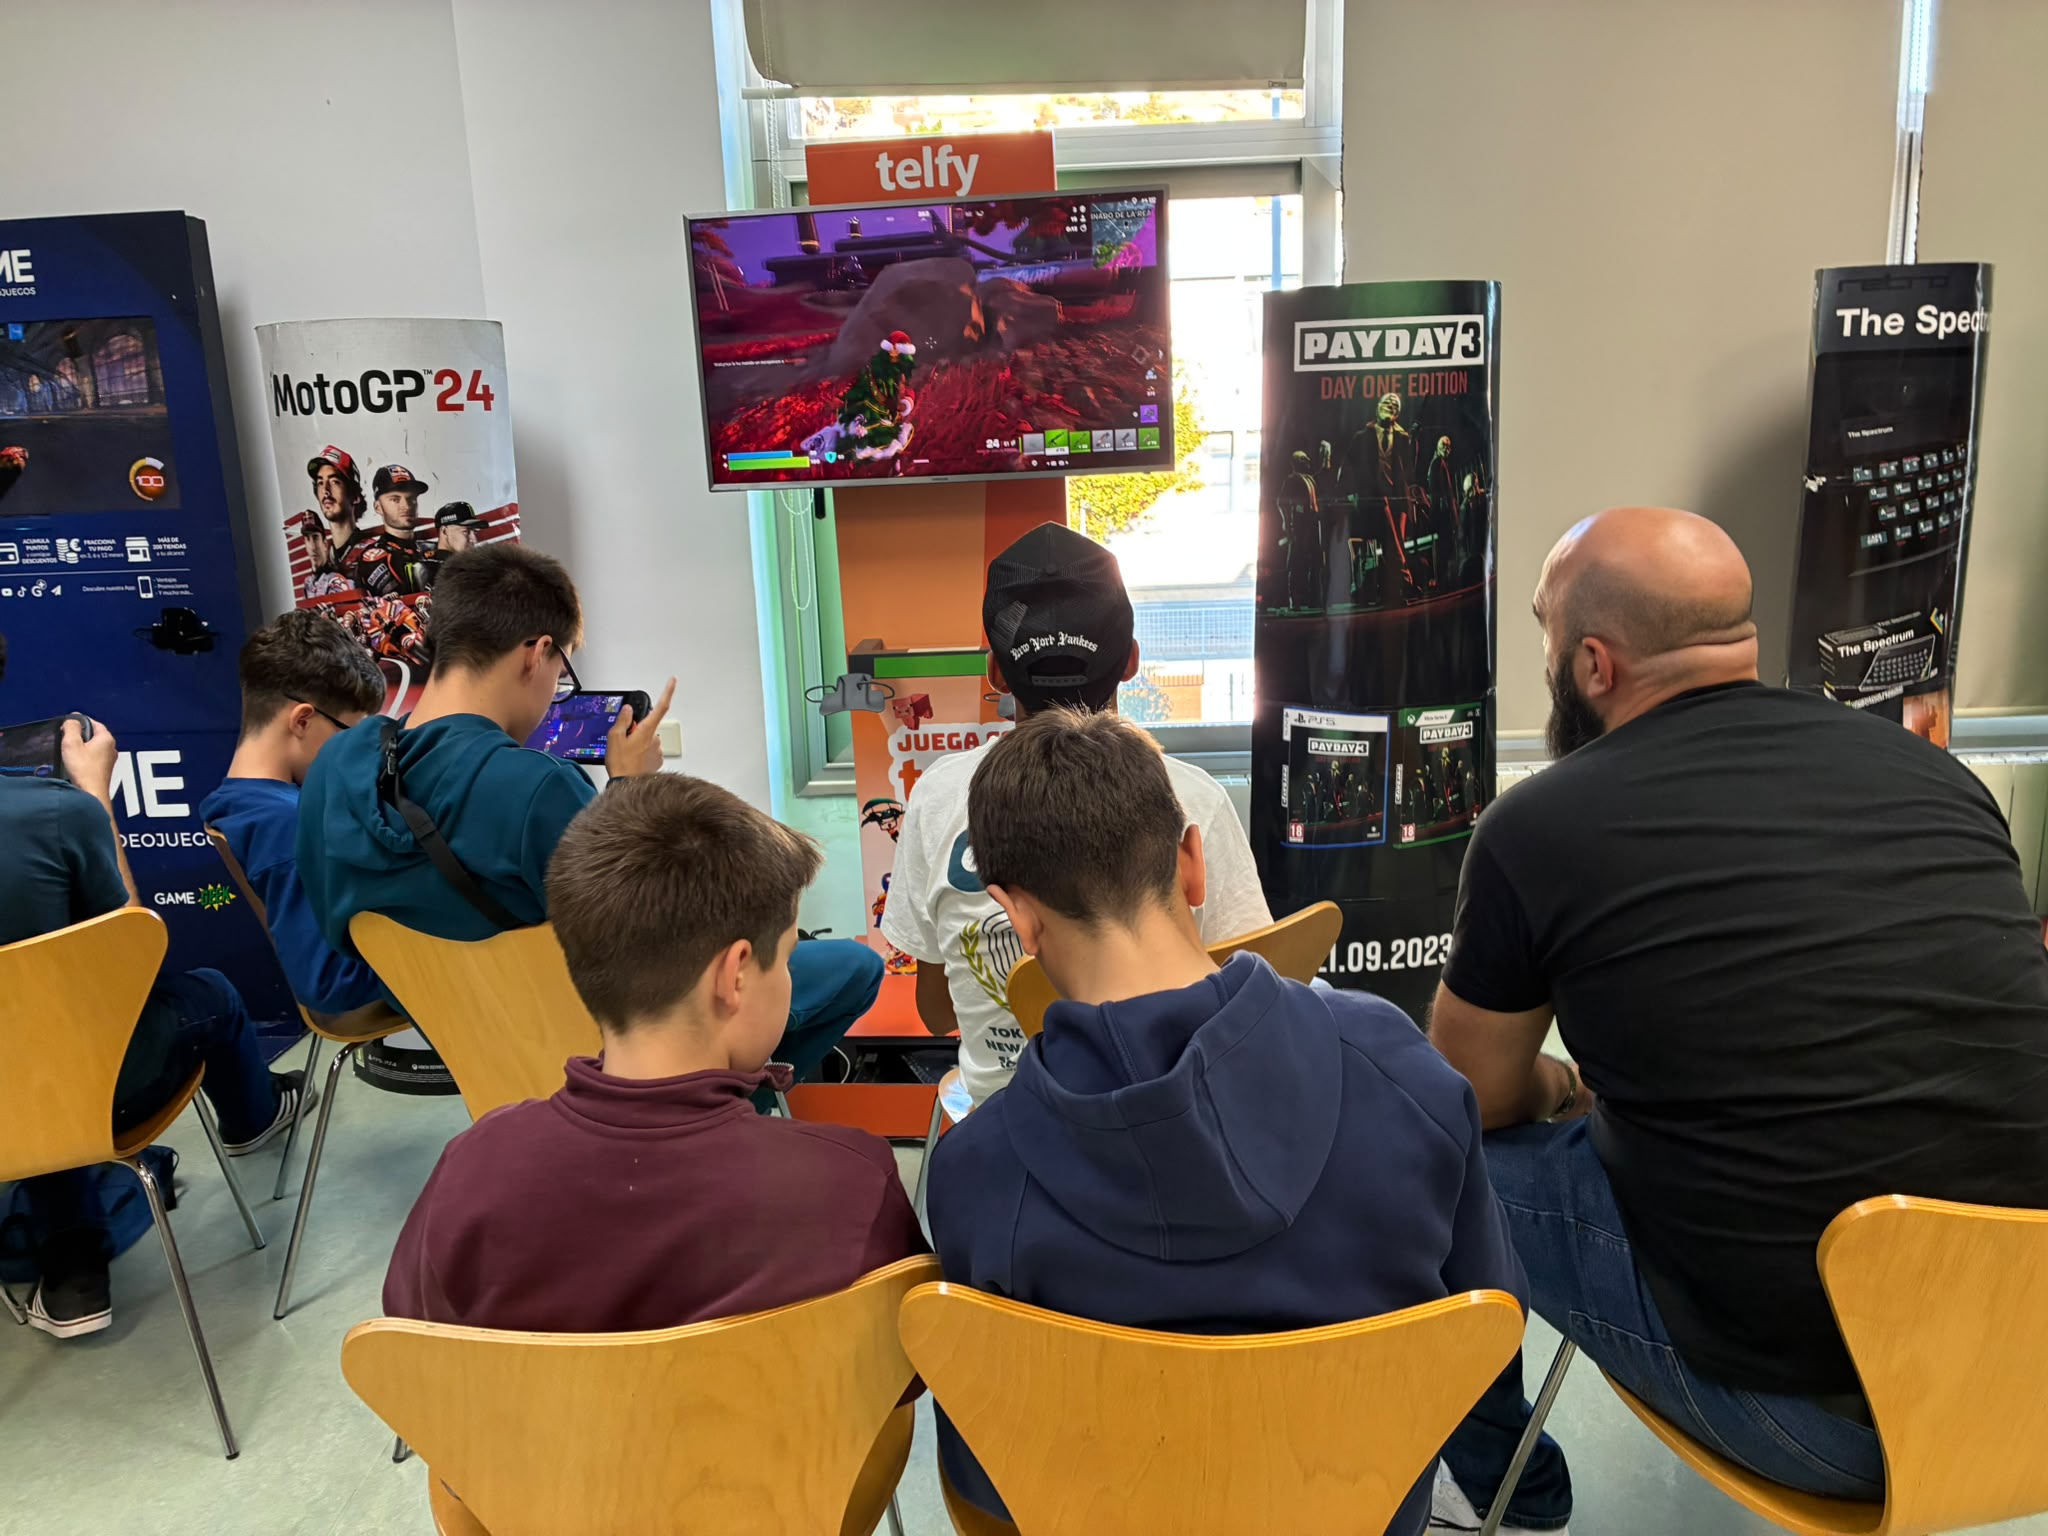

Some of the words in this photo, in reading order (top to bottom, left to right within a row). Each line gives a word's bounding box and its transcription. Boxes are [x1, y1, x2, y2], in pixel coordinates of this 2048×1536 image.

[875, 144, 980, 197] telfy
[0, 287, 36, 296] JUEGOS
[1836, 307, 1904, 337] The
[1304, 327, 1454, 360] PAYDAY
[434, 369, 495, 412] 24
[1320, 376, 1357, 400] DAY
[1362, 374, 1402, 399] ONE
[1407, 371, 1468, 396] EDITION
[1010, 643, 1030, 661] New
[1029, 634, 1055, 653] York
[1057, 631, 1099, 653] Yankees
[1837, 643, 1860, 658] The
[1863, 629, 1914, 653] Spectrum
[897, 732, 980, 752] JUEGA
[1423, 726, 1460, 741] PAYDAY
[1311, 741, 1355, 752] PAYDAY
[1291, 826, 1302, 837] 18
[1403, 826, 1414, 837] 18
[154, 892, 195, 905] GAME
[985, 1039, 1020, 1054] NEW
